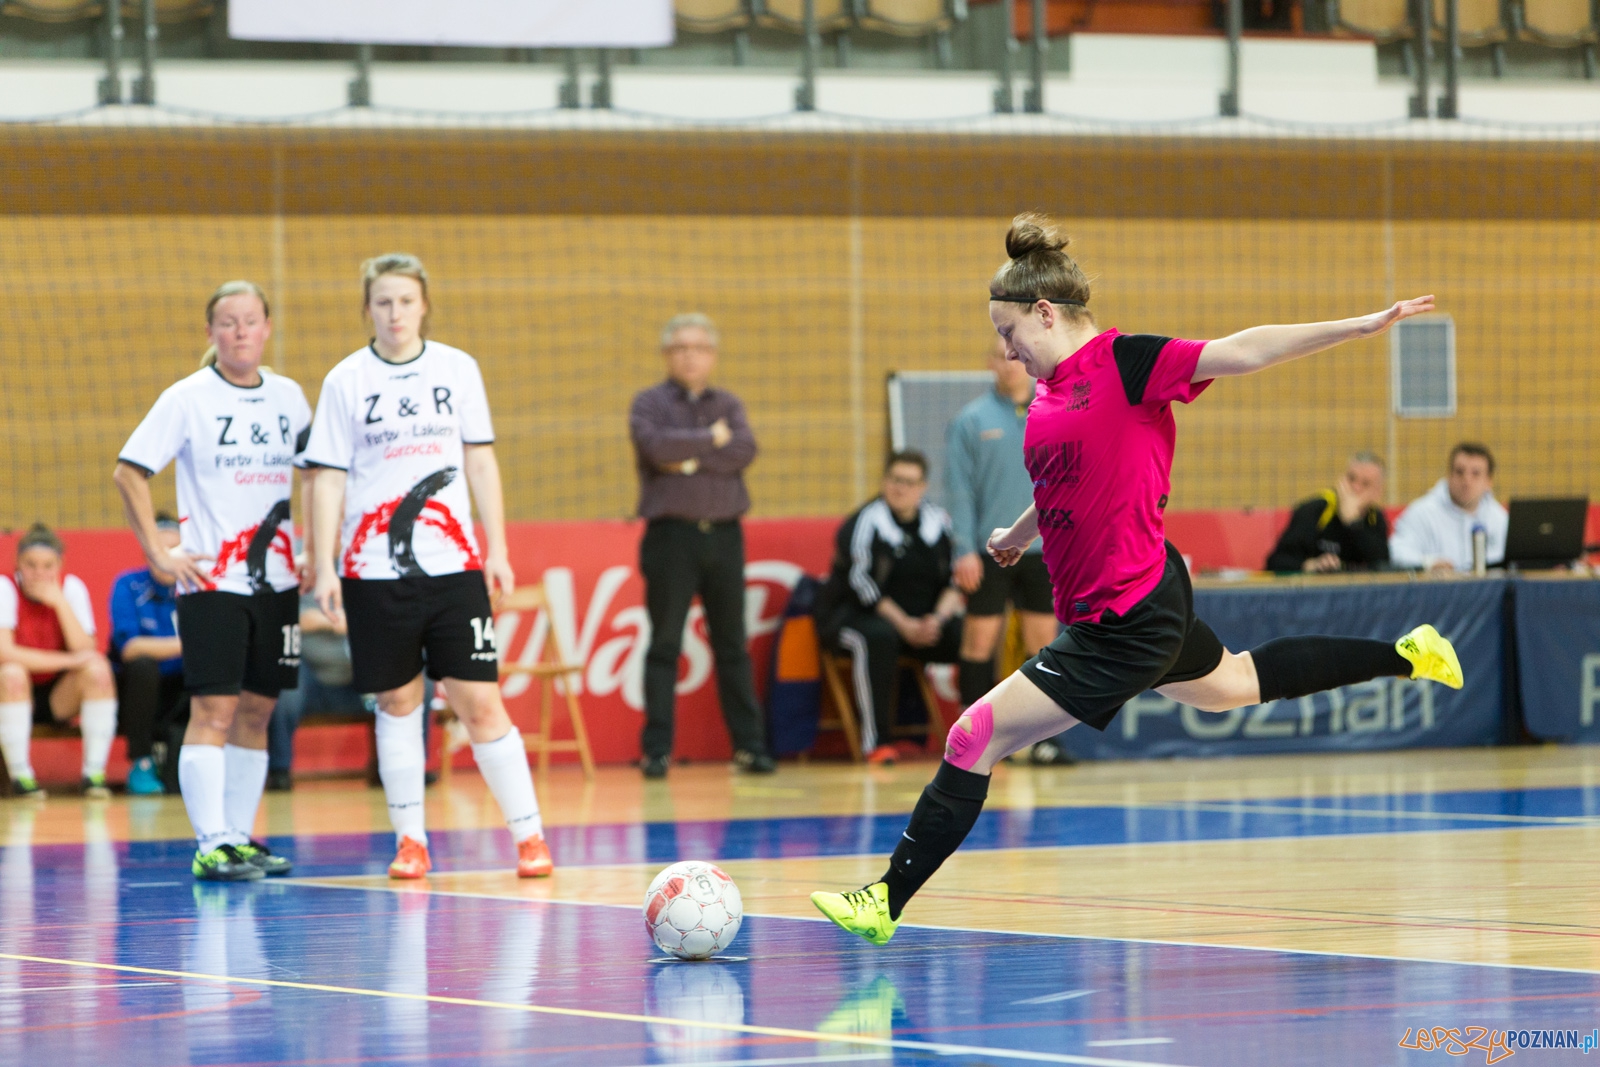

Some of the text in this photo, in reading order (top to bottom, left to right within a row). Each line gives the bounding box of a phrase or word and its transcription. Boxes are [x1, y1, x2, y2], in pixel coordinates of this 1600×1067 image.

[365, 386, 453, 424] Z & R
[216, 414, 293, 446] Z & R
[470, 616, 496, 650] 14
